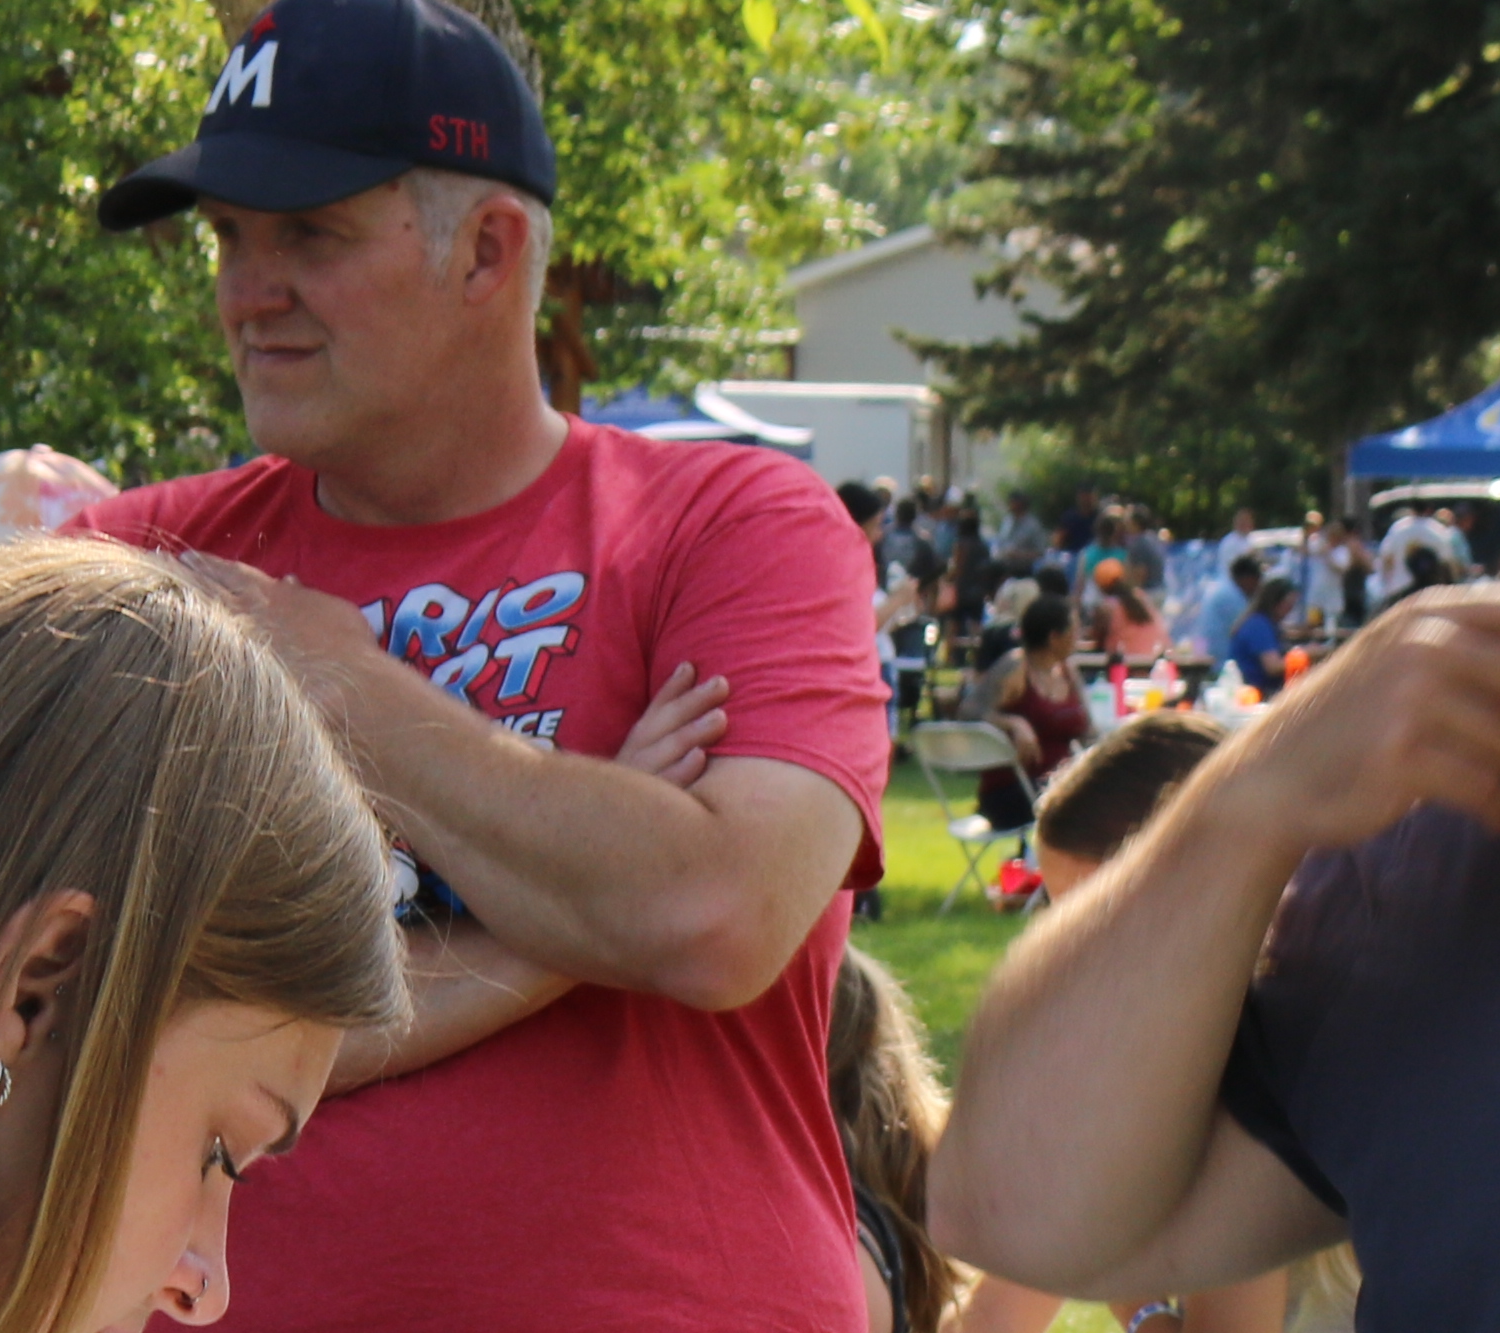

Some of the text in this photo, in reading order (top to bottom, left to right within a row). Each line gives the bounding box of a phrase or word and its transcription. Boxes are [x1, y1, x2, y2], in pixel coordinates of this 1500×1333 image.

[204, 40, 279, 115] M
[428, 114, 490, 161] STH
[360, 570, 588, 660] RIO
[429, 624, 580, 706] RT
